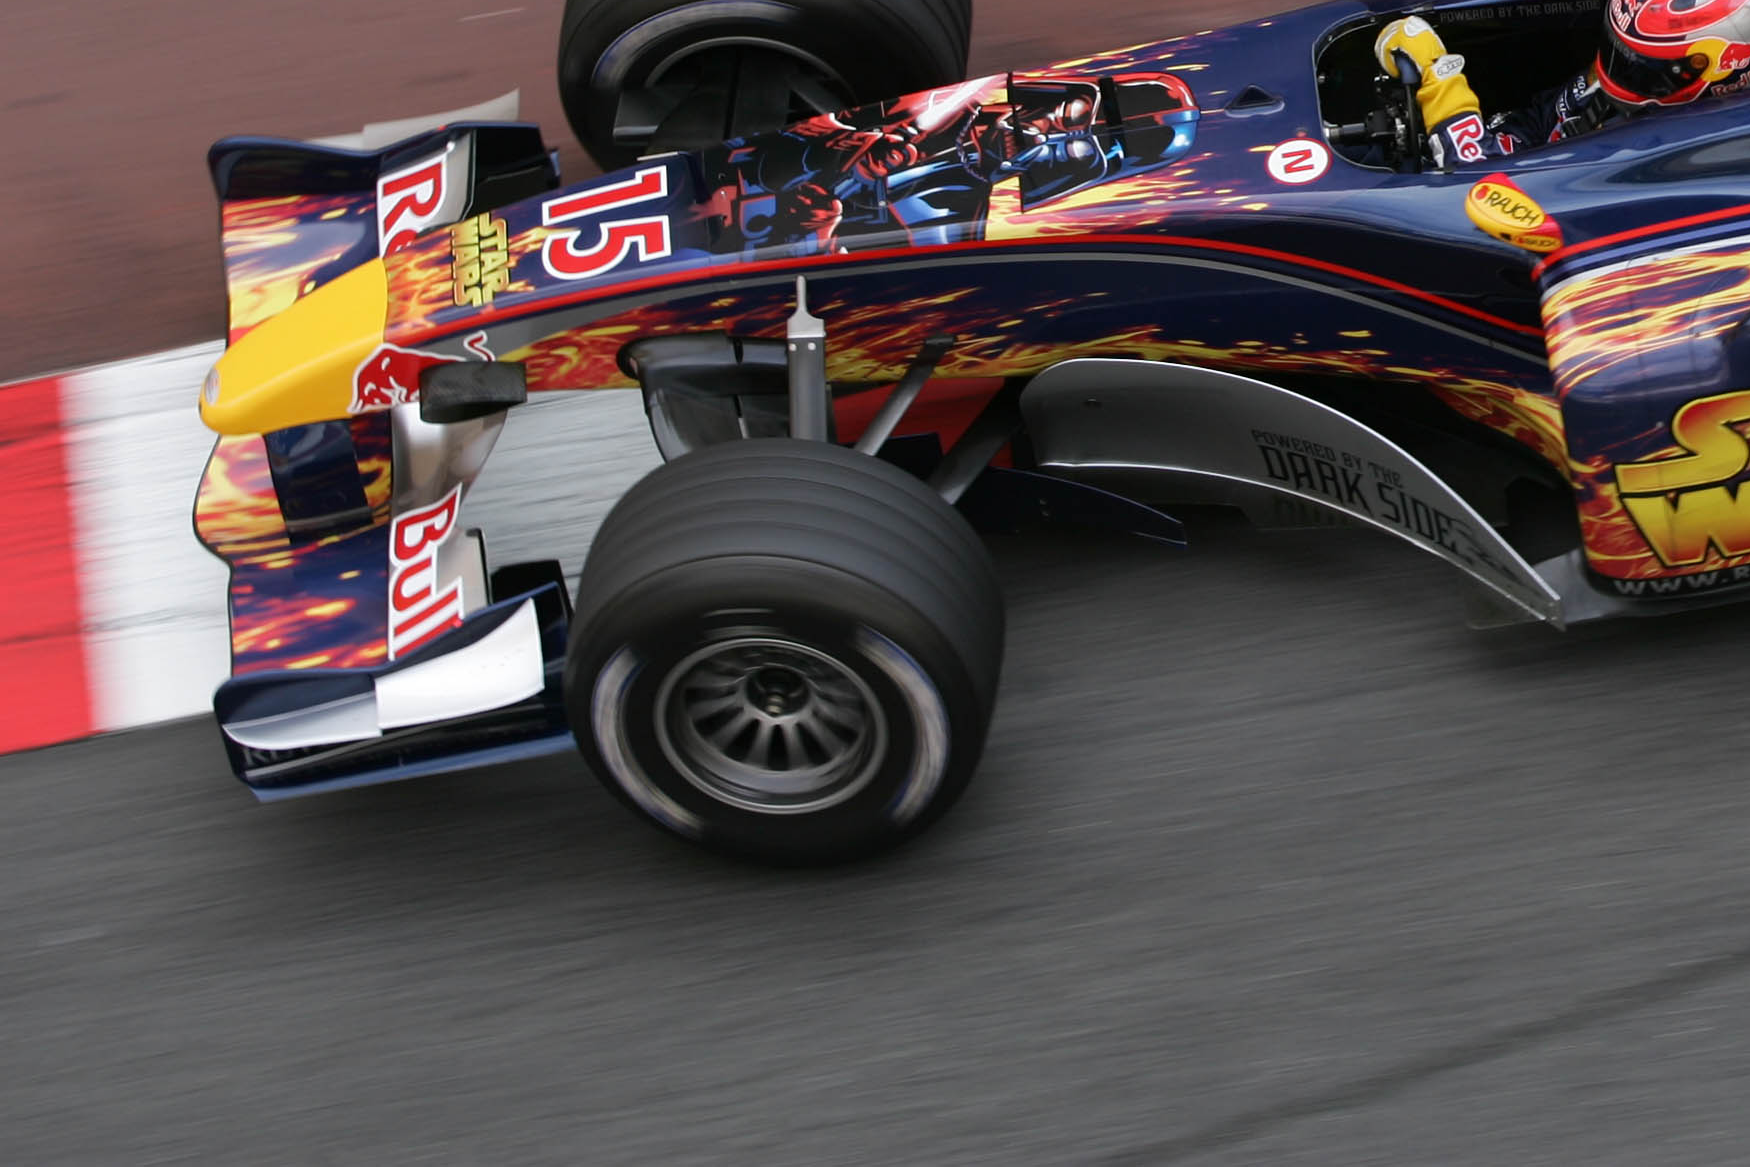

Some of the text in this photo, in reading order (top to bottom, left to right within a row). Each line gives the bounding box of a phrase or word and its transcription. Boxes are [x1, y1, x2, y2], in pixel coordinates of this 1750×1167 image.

[1440, 7, 1495, 23] POWERED
[1498, 6, 1513, 19] BY
[1515, 3, 1542, 18] THE
[1448, 115, 1486, 162] Re
[542, 165, 671, 280] 15
[1485, 191, 1541, 226] RAUCH
[452, 216, 485, 307] WARS
[477, 212, 510, 305] STAR
[1250, 428, 1403, 489] POWERED BY THE
[1259, 444, 1375, 517] DARK
[1376, 481, 1458, 556] SIDE
[392, 487, 462, 660] Bull
